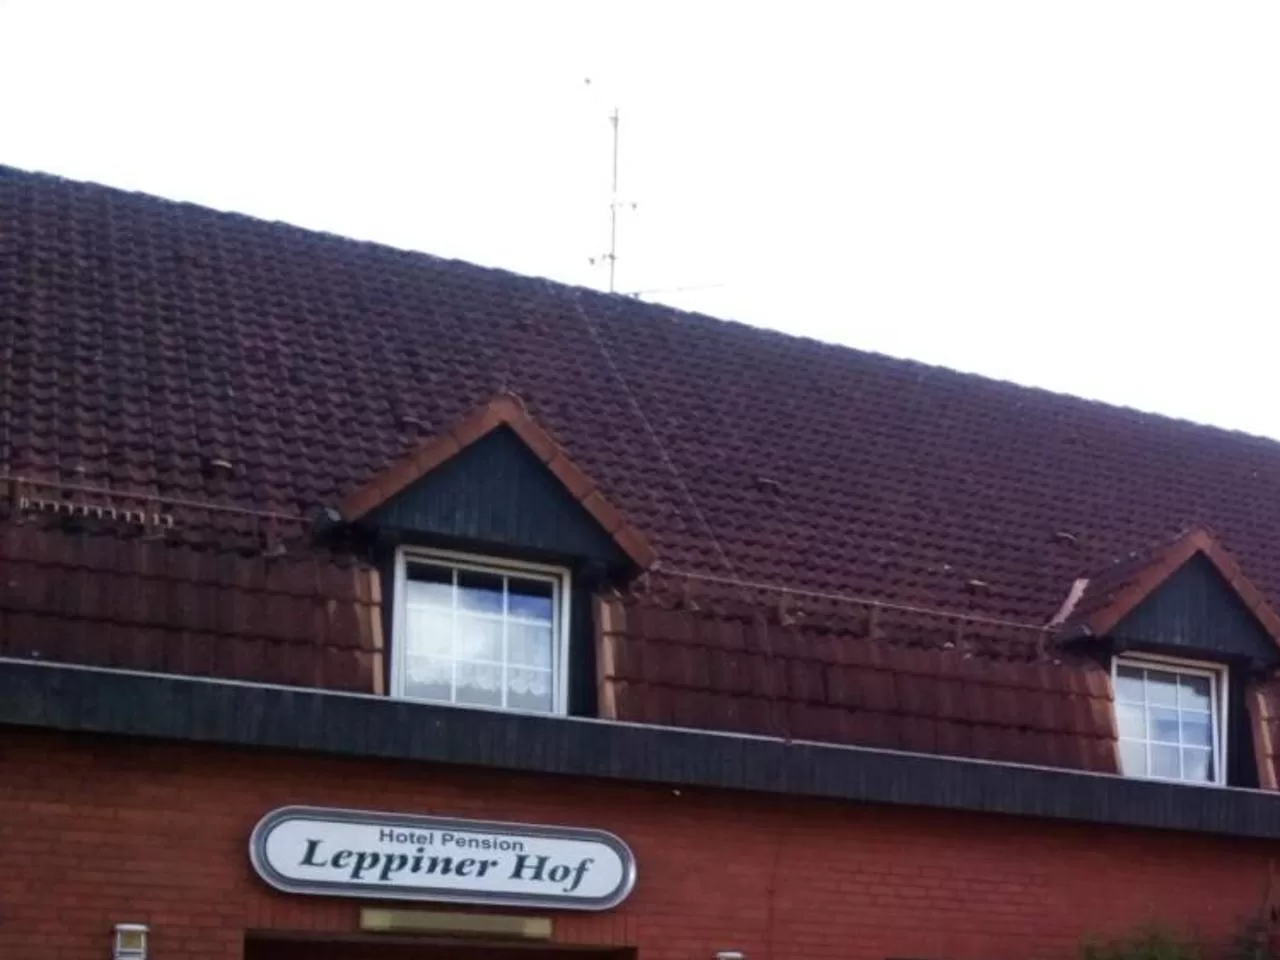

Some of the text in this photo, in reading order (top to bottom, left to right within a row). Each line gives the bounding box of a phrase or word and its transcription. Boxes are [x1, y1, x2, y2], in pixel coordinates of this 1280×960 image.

[379, 829, 524, 851] Hotel Pension
[299, 838, 595, 893] Leppiner Hof
